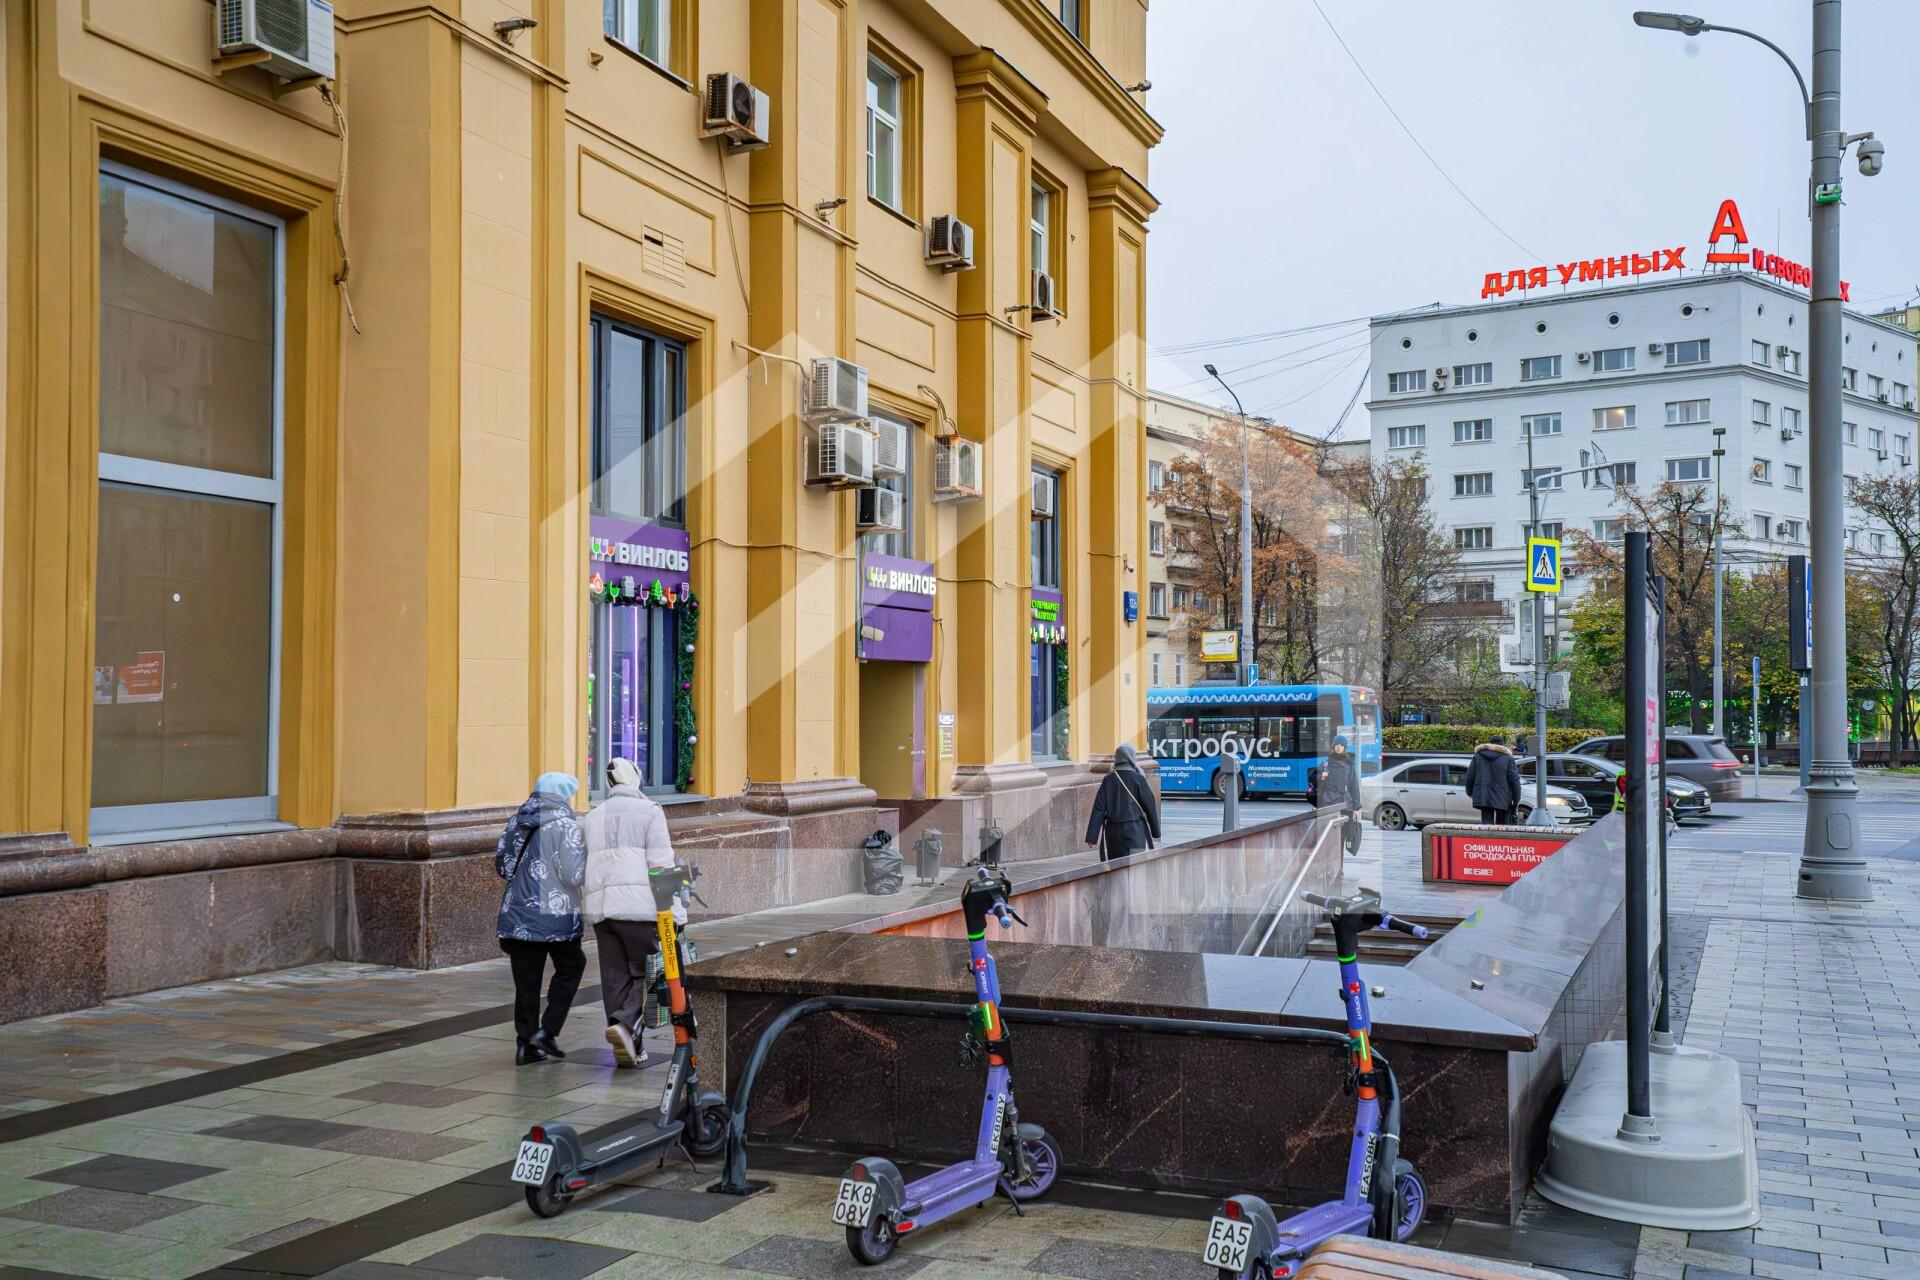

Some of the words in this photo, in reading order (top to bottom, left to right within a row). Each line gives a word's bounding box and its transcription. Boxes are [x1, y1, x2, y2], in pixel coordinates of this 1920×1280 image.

[1708, 199, 1749, 244] А
[1481, 266, 1548, 299] ДЛЯ
[1556, 246, 1686, 285] УМНЫХ
[1752, 247, 1765, 272] И
[1766, 253, 1850, 303] СВОБОХ
[616, 542, 689, 572] ВИНЛАБ
[890, 570, 937, 595] ВИНЛАБ
[1152, 730, 1280, 765] ктробус.
[1463, 843, 1535, 855] ОФИЦИАЛЬНАЯ
[1463, 851, 1517, 861] ГОРОДСКАЯ
